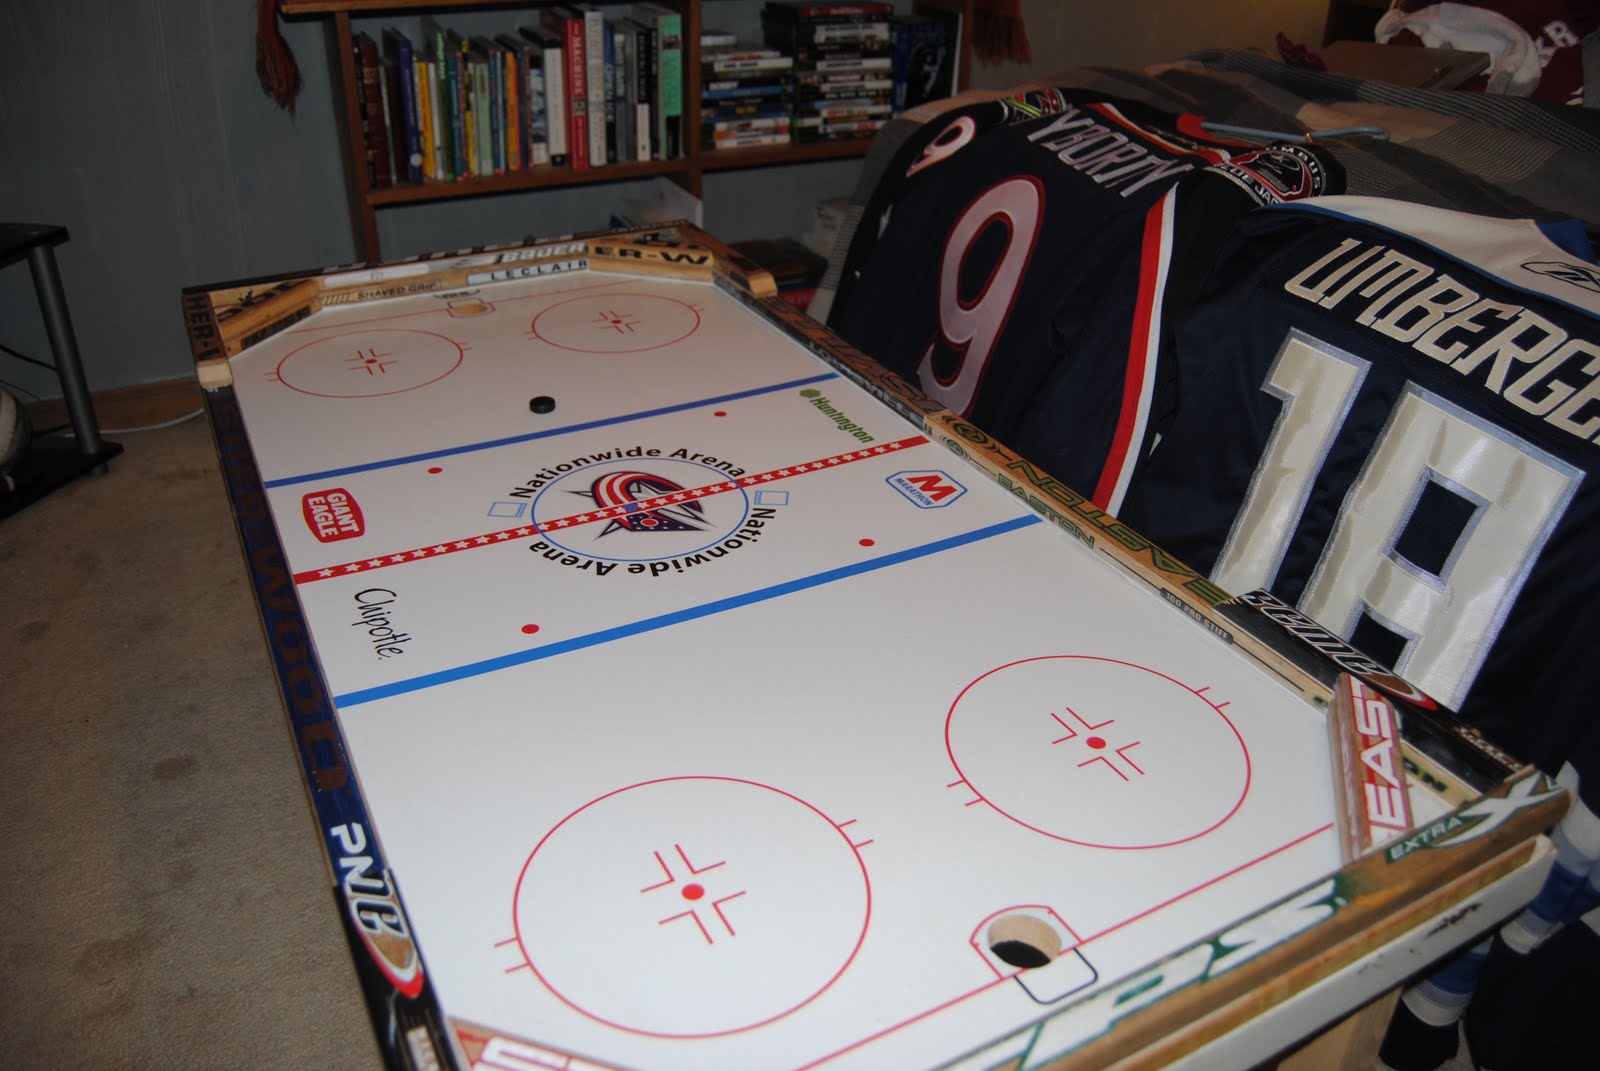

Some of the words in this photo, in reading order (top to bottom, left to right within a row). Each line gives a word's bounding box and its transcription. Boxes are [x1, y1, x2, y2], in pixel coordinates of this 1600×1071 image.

[490, 258, 588, 281] LECLAIR
[1284, 238, 1600, 447] UMBERGE
[810, 396, 874, 444] Huntington
[510, 446, 661, 498] Nationwide
[671, 447, 746, 479] Arena
[307, 496, 338, 537] EAGLE
[325, 492, 359, 534] GIANT
[997, 472, 1096, 548] EASTON
[628, 507, 775, 577] Nationwide
[1006, 459, 1235, 608] EASTON
[529, 541, 616, 577] Arena
[1182, 605, 1203, 622] PRO
[1202, 617, 1230, 640] STIFF
[1389, 814, 1463, 859] EXTRA
